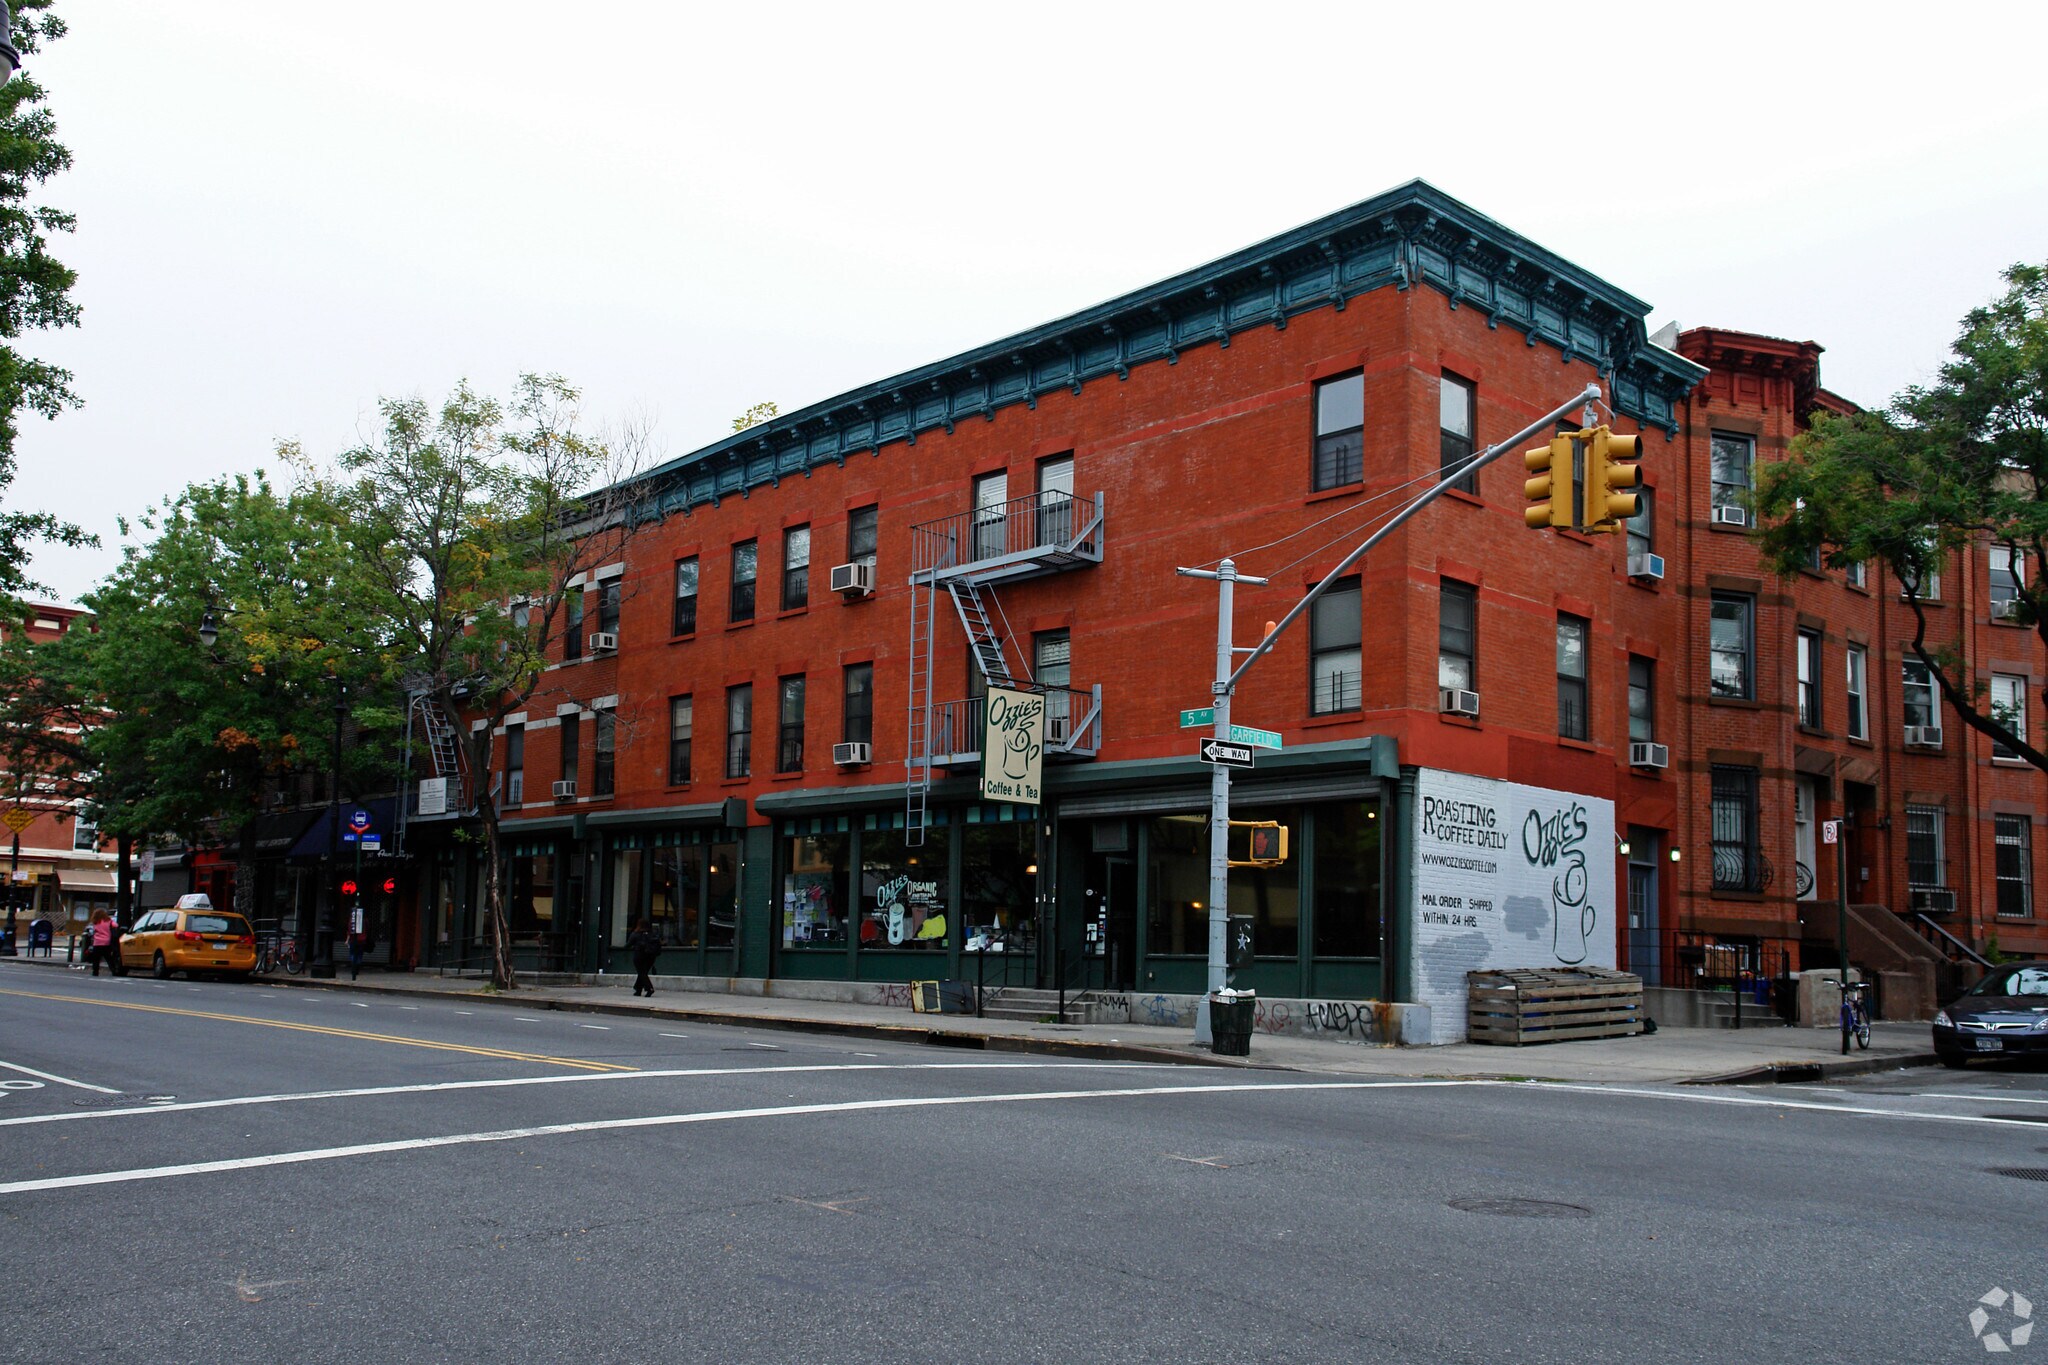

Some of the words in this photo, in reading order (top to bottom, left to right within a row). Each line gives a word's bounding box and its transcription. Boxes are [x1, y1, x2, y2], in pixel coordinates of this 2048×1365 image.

[1188, 712, 1195, 725] 5
[1200, 710, 1208, 718] AV
[1231, 727, 1273, 746] GARFIELD
[1209, 746, 1225, 757] ONE
[1232, 750, 1247, 759] WAY
[987, 781, 1012, 796] Coffee
[1015, 783, 1022, 797] &
[1025, 785, 1038, 799] Tea
[1422, 796, 1496, 835] ROASTING
[1437, 824, 1475, 845] COFFEE
[1477, 829, 1509, 850] DAILY
[907, 880, 937, 898] ORGANIC
[1422, 894, 1438, 907] MAIL
[1438, 895, 1462, 909] ORDER
[1468, 898, 1493, 912] SHIPPED
[1422, 911, 1449, 925] WITHIN
[1451, 914, 1461, 925] 24
